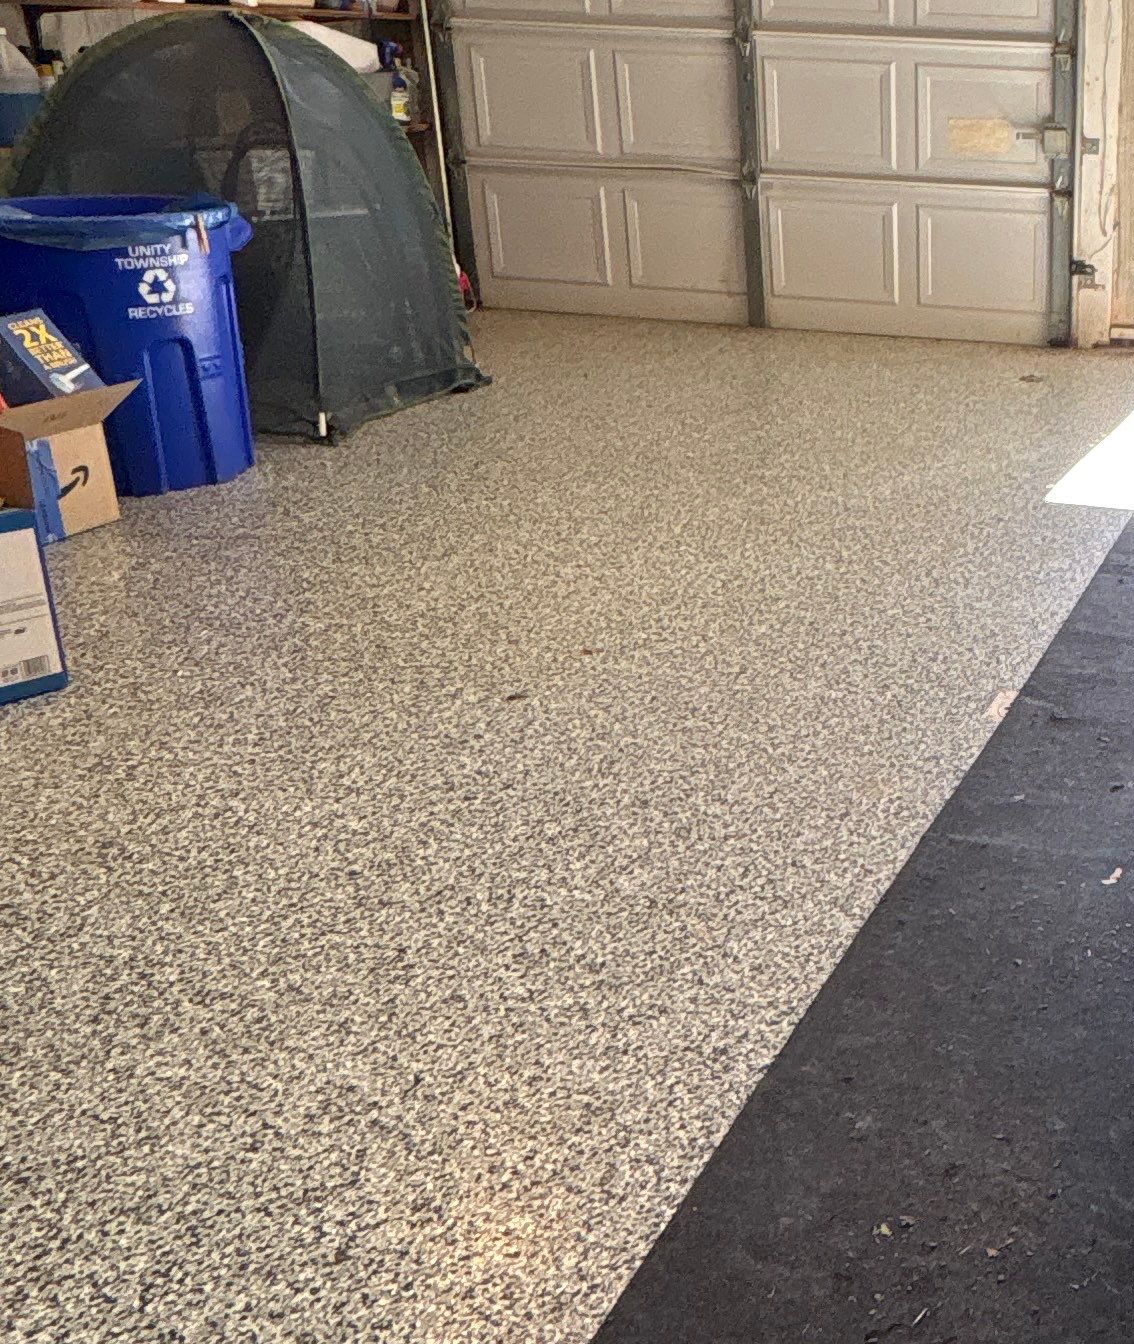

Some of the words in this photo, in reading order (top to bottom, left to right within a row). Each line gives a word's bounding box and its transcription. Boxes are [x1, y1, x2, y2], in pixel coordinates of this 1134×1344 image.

[127, 242, 172, 258] UNITY
[114, 253, 189, 271] TOWNSHIP
[127, 301, 195, 320] RECYCLES
[13, 323, 58, 349] 2X
